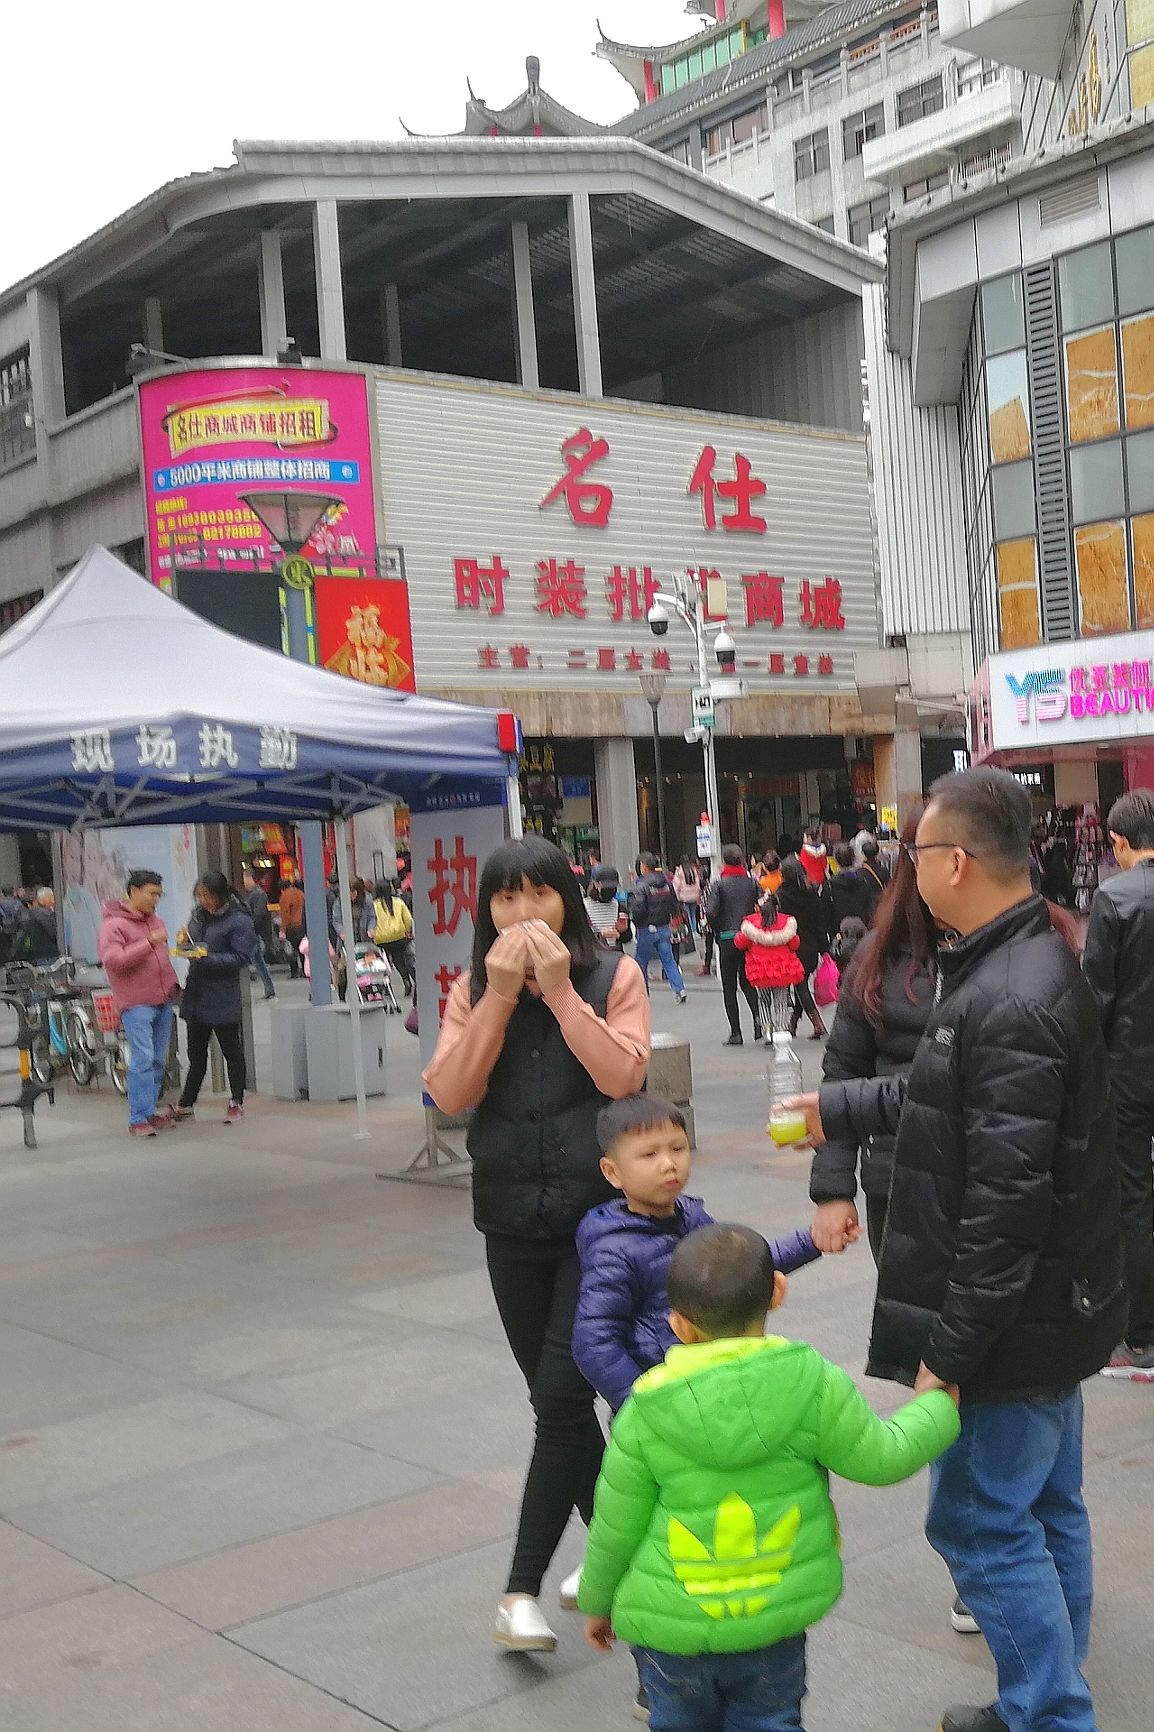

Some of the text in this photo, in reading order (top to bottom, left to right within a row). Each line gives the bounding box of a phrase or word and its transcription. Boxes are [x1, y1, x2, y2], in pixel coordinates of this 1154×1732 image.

[538, 426, 768, 535] 名仕
[453, 554, 846, 631] 时装批商城
[70, 724, 298, 773] 现场执勤
